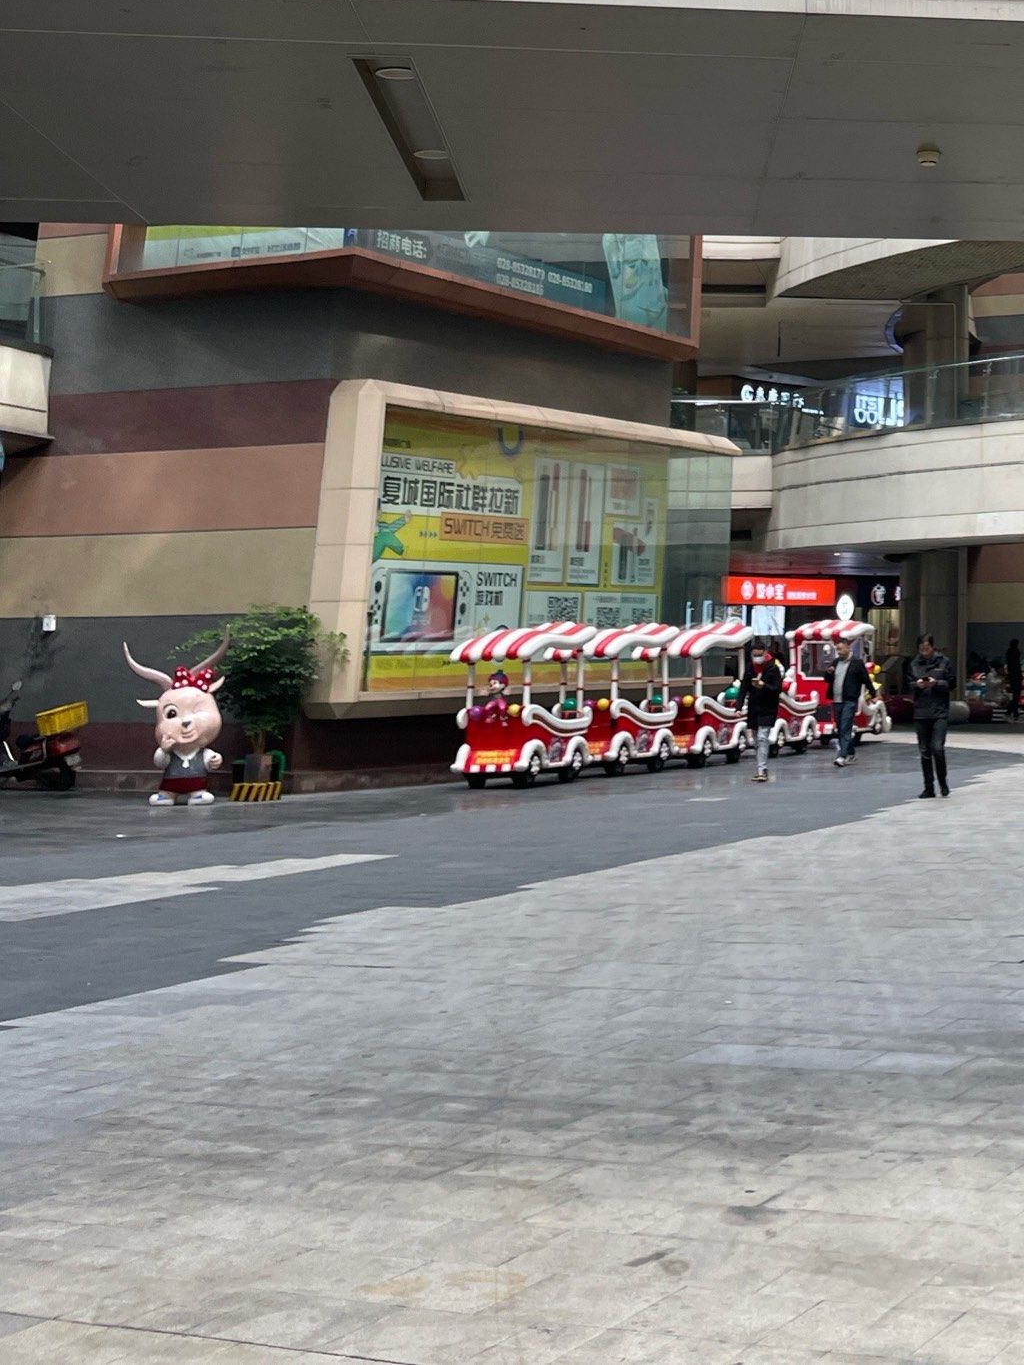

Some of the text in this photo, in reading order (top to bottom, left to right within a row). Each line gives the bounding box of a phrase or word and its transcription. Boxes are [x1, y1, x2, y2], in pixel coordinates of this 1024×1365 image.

[414, 458, 454, 474] WELFARE
[444, 517, 489, 537] SWITCH
[476, 571, 518, 588] SWITCH
